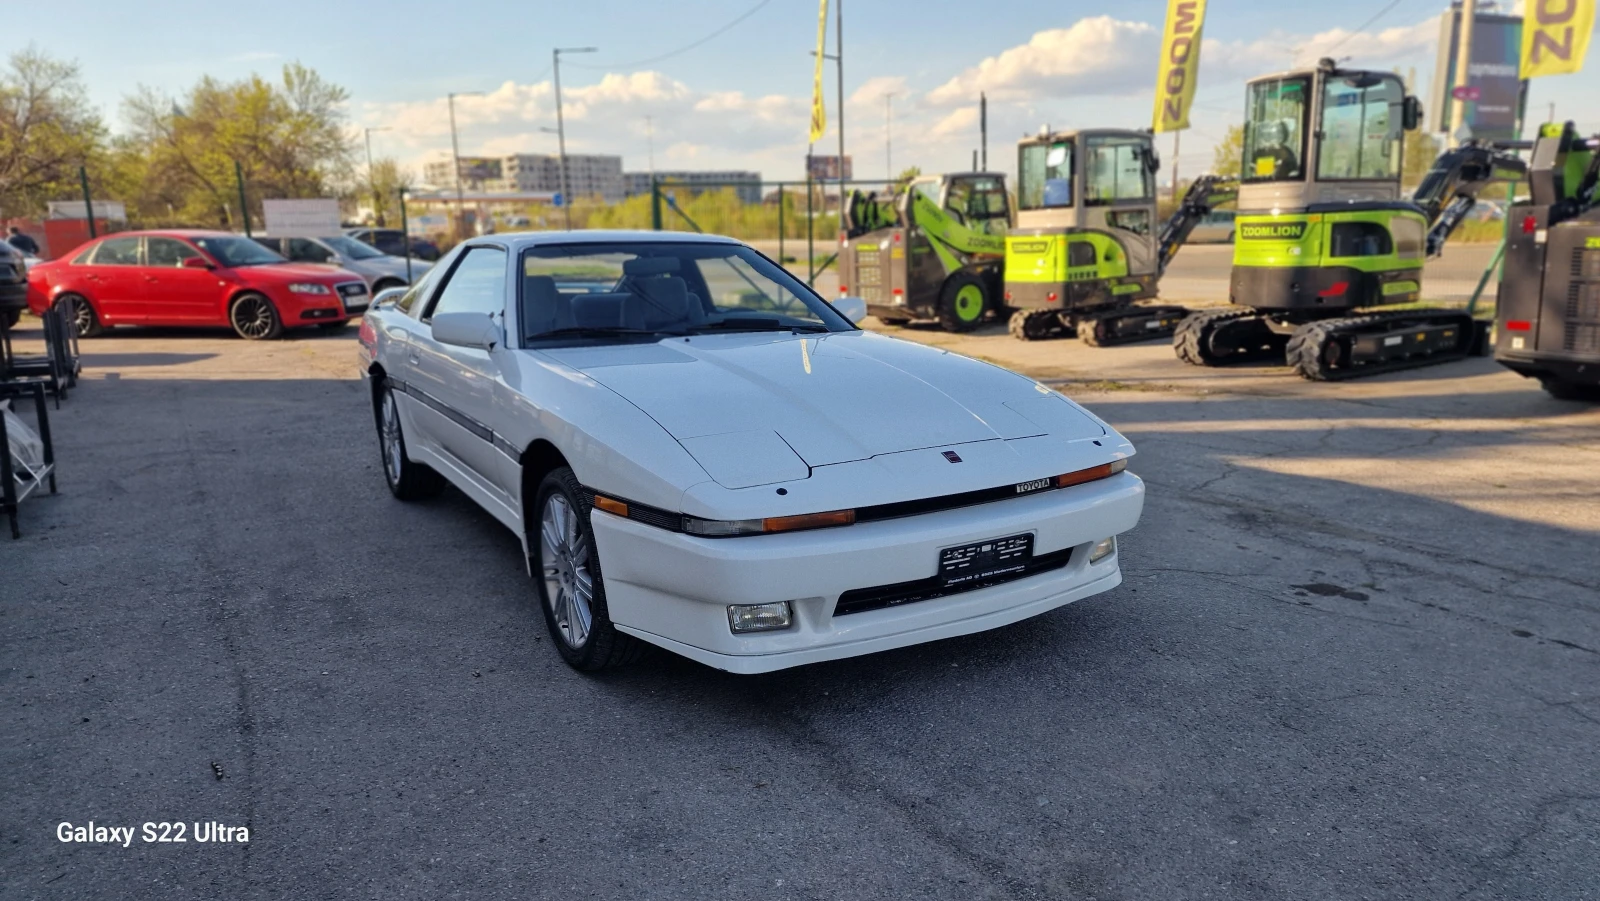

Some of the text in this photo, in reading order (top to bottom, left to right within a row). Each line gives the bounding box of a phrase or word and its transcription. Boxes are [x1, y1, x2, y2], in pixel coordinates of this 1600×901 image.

[1162, 1, 1197, 124] ZOOM
[1242, 226, 1301, 236] ZOOMLION
[1018, 479, 1049, 491] TOYOTA
